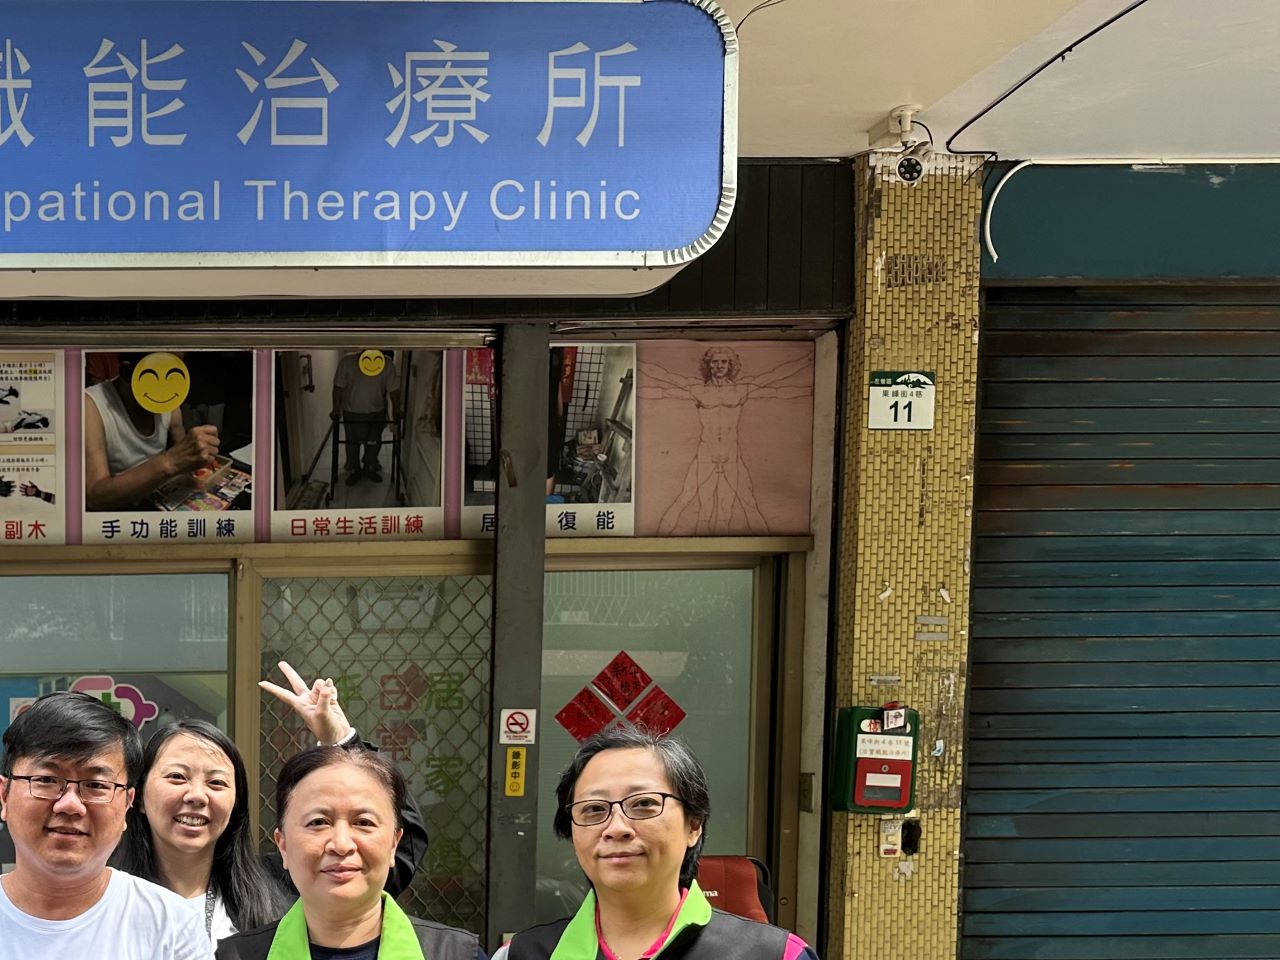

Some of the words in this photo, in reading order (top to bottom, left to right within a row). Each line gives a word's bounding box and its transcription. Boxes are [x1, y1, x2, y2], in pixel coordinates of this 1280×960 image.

[243, 179, 469, 232] Therapy
[488, 179, 642, 222] Clinic
[888, 400, 913, 423] 11
[101, 517, 236, 540] 手功能訓練
[289, 514, 425, 537] 日常生活訓練
